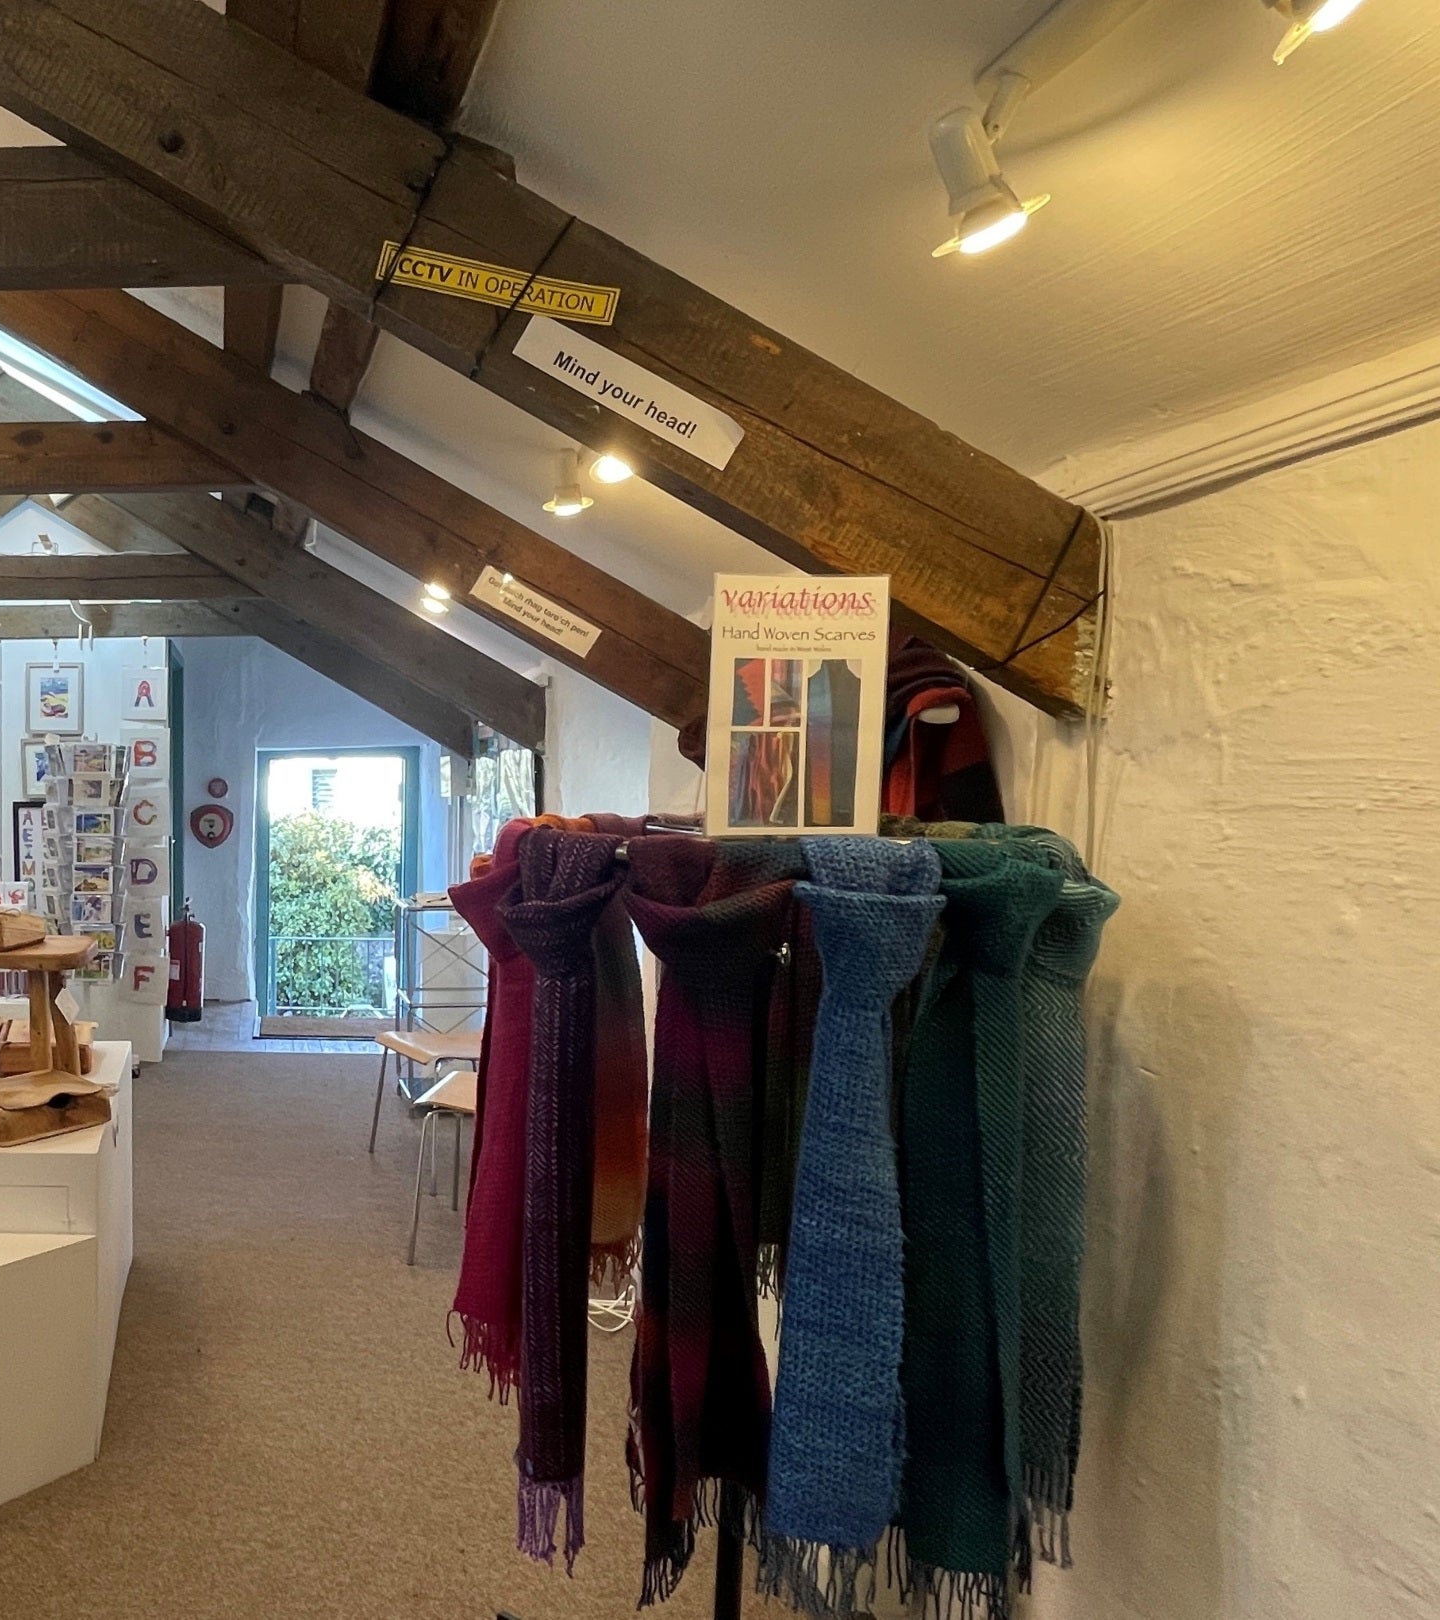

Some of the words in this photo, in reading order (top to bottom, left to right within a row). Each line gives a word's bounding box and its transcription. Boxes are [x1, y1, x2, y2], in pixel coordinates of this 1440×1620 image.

[397, 257, 454, 283] CCTV
[457, 271, 480, 290] IN
[484, 276, 596, 312] OPERATION
[552, 350, 600, 386] Mind
[598, 379, 644, 409] your
[644, 400, 698, 439] head!
[503, 597, 522, 613] Mind
[522, 609, 540, 625] your
[721, 585, 875, 612] variations
[722, 622, 760, 640] Hand
[763, 627, 810, 641] Woven
[813, 627, 876, 641] Scarves
[134, 680, 155, 708] A
[134, 740, 157, 767] B
[132, 799, 158, 826] C
[130, 858, 158, 886] D
[134, 913, 154, 939] E
[133, 965, 155, 992] F
